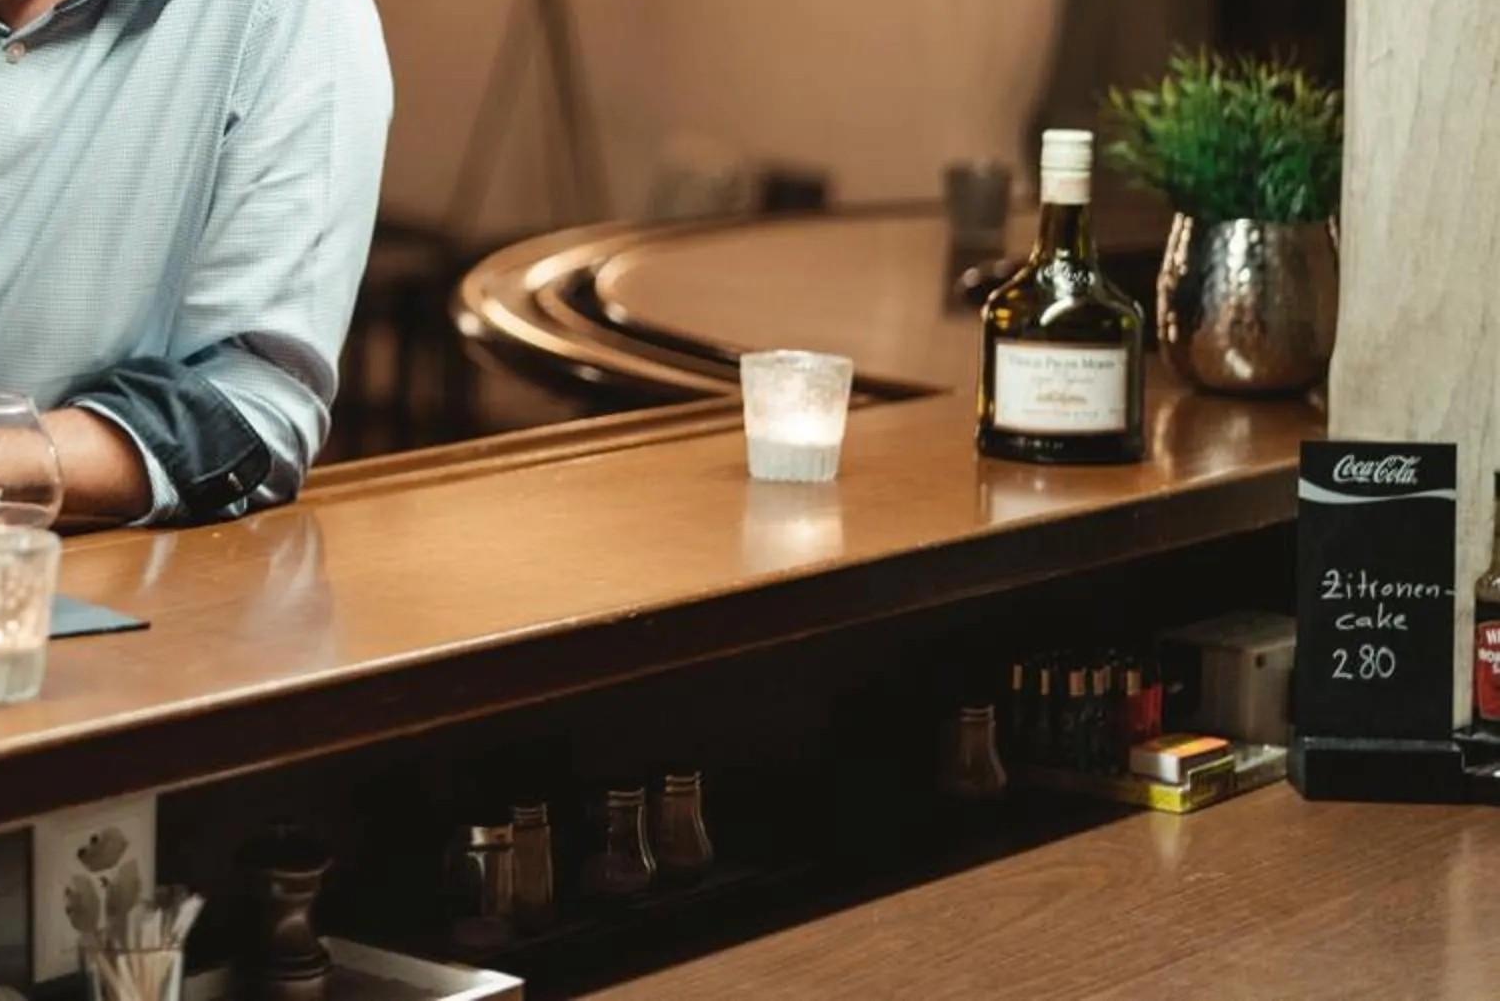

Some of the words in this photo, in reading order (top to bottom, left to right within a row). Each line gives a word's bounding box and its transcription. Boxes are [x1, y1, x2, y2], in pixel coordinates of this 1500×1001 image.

[1333, 454, 1420, 483] Coca-Cola
[1321, 569, 1456, 599] Zitronen-
[1335, 603, 1408, 630] cake
